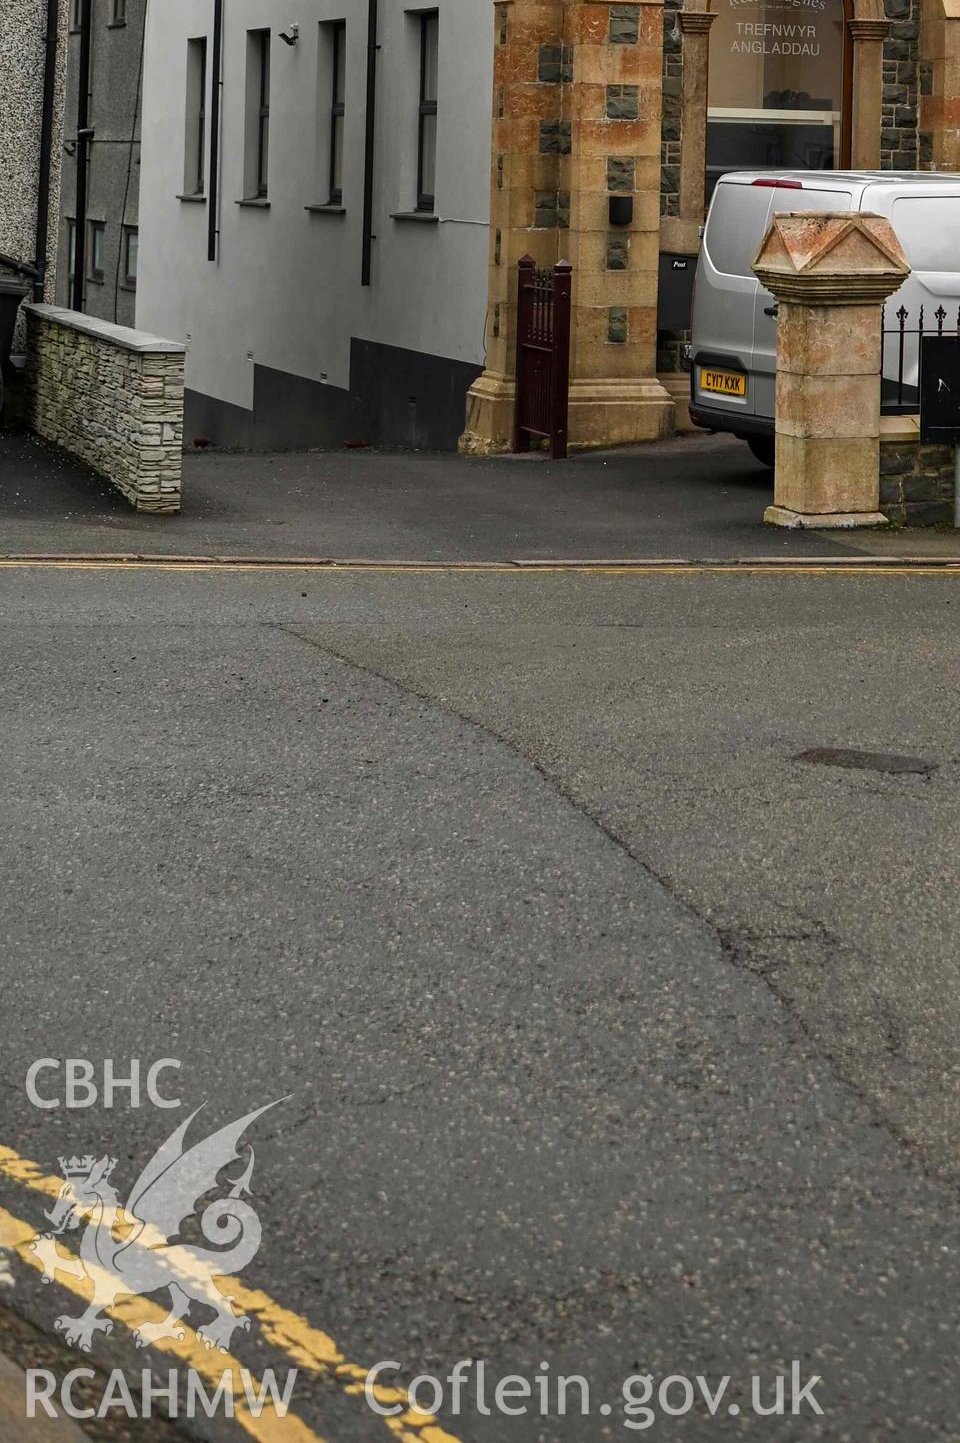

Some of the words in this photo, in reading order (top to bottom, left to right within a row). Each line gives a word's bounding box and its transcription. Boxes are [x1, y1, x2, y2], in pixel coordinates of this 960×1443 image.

[736, 23, 816, 37] TREFNWYR
[731, 41, 820, 55] ANGLADDAU
[706, 373, 723, 388] CY17
[725, 377, 740, 391] KXK
